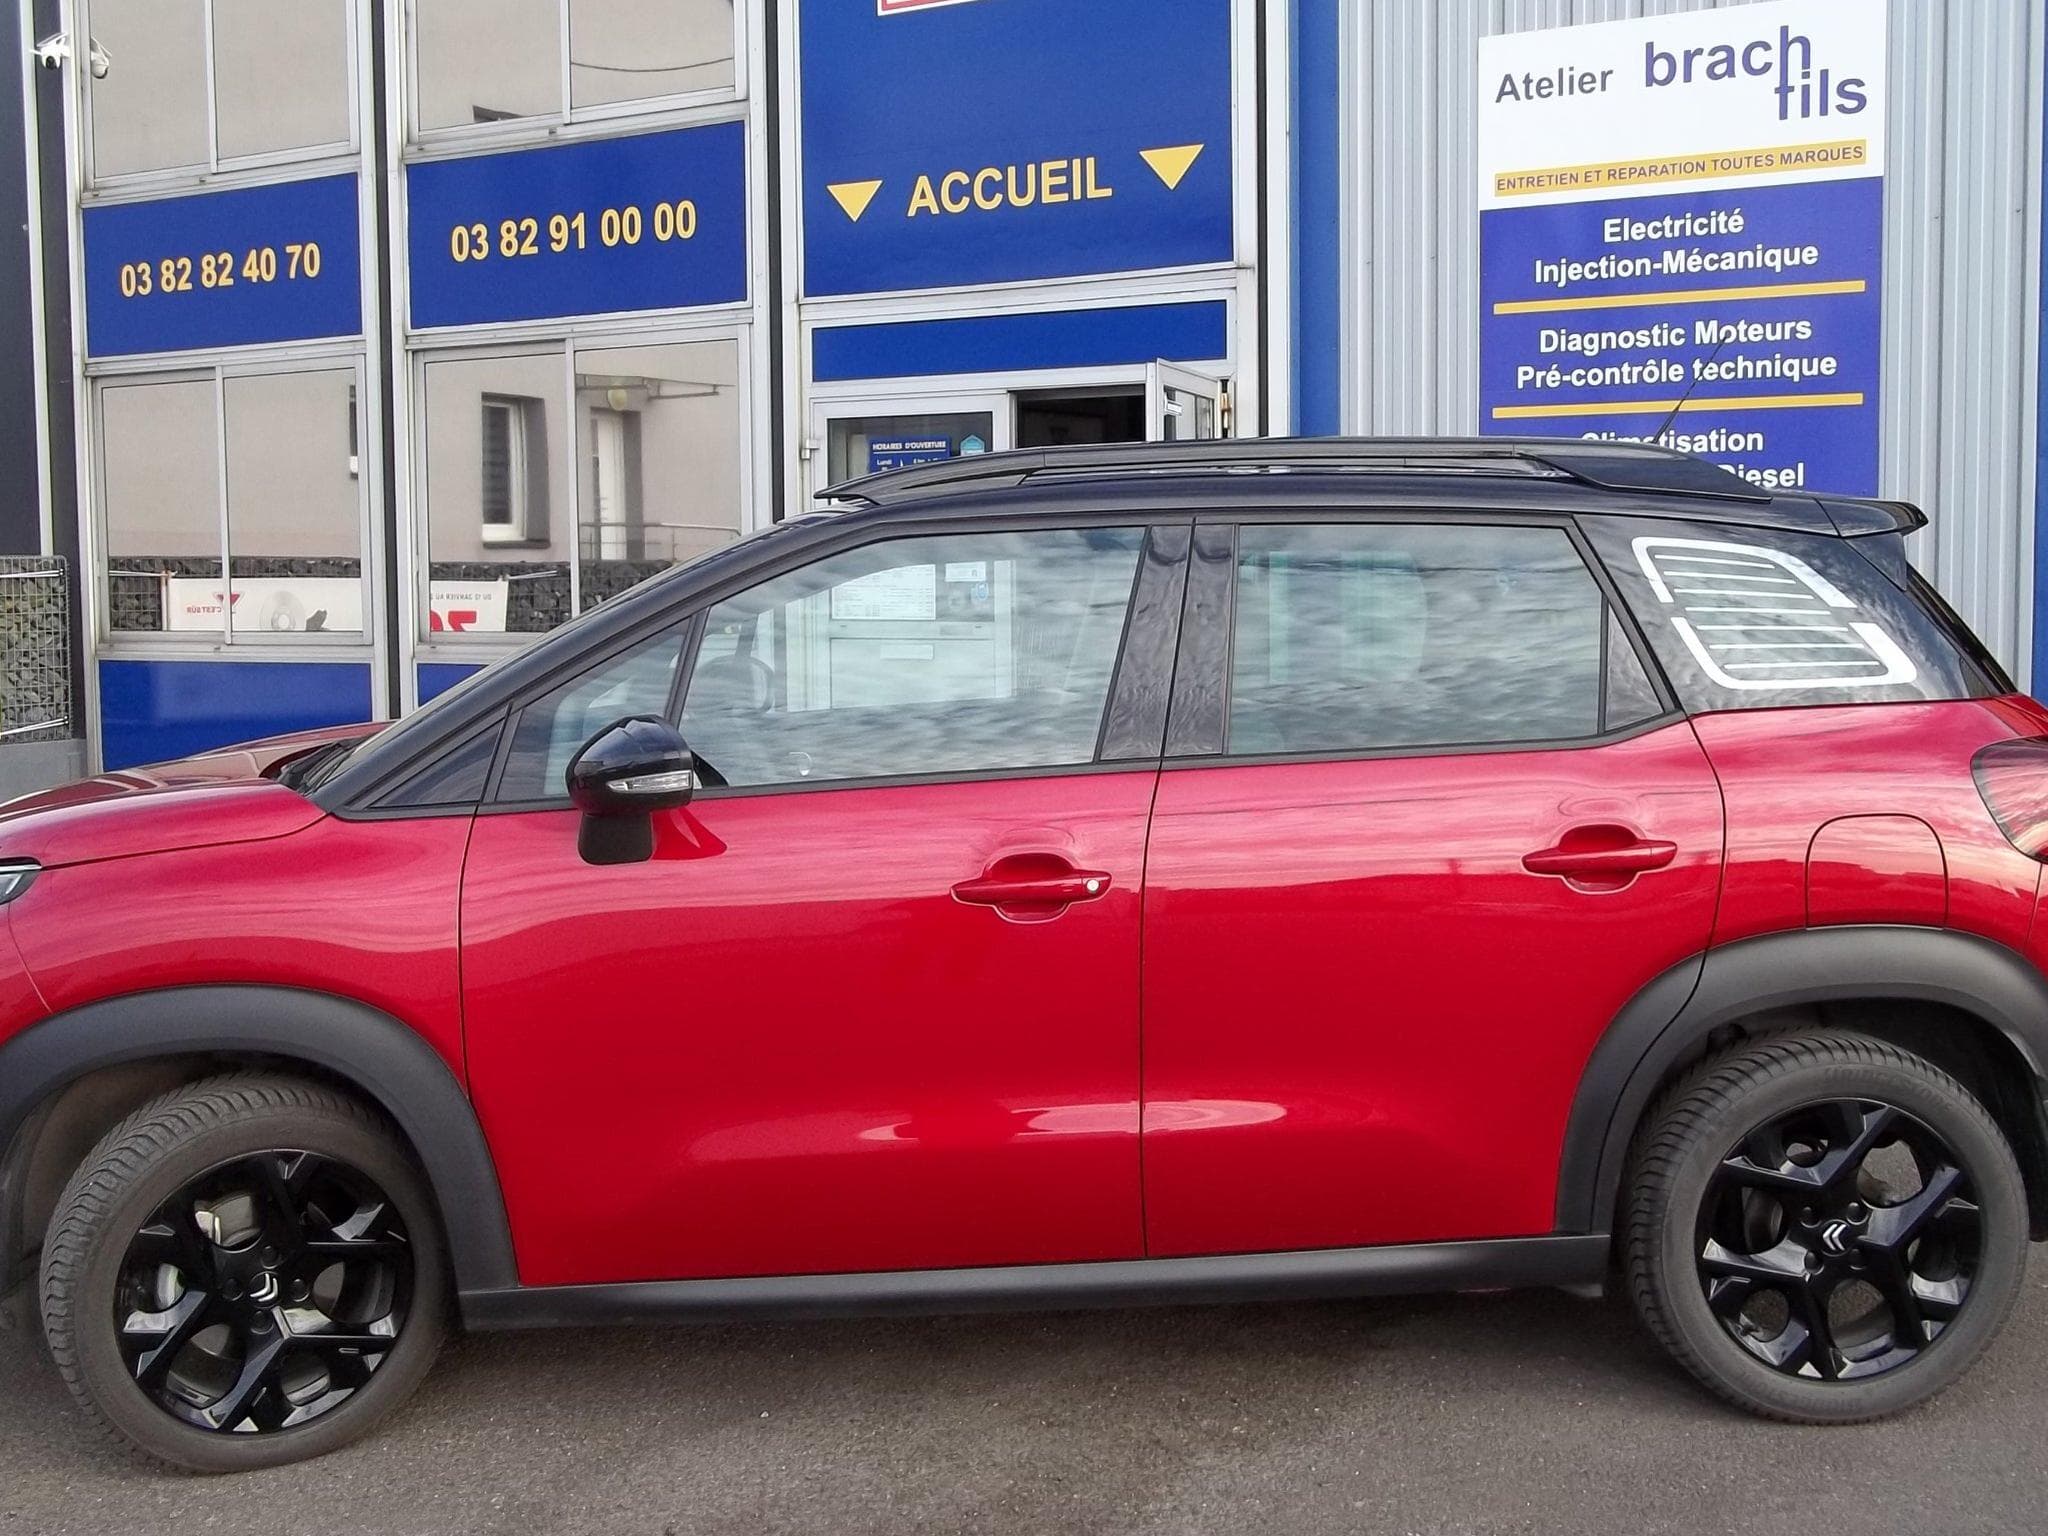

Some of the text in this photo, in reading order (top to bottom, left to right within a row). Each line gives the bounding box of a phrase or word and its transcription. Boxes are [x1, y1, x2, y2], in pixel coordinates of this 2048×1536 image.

[1495, 25, 1811, 103] Atelier brach
[907, 156, 1113, 217] ACCUEIL
[1497, 145, 1863, 192] ENTRETIEN ET REPARATION TOUTES MARQUES
[450, 199, 697, 263] 03 82 91 00 00
[1603, 208, 1745, 243] Electricité
[120, 241, 321, 298] 03 82 82 40 70
[1535, 243, 1819, 288] Injection-Mécanique
[1539, 319, 1813, 356] Diagnostic Moteurs
[1517, 354, 1838, 389] Pré-contrôle technique
[1581, 428, 1764, 452] tisation
